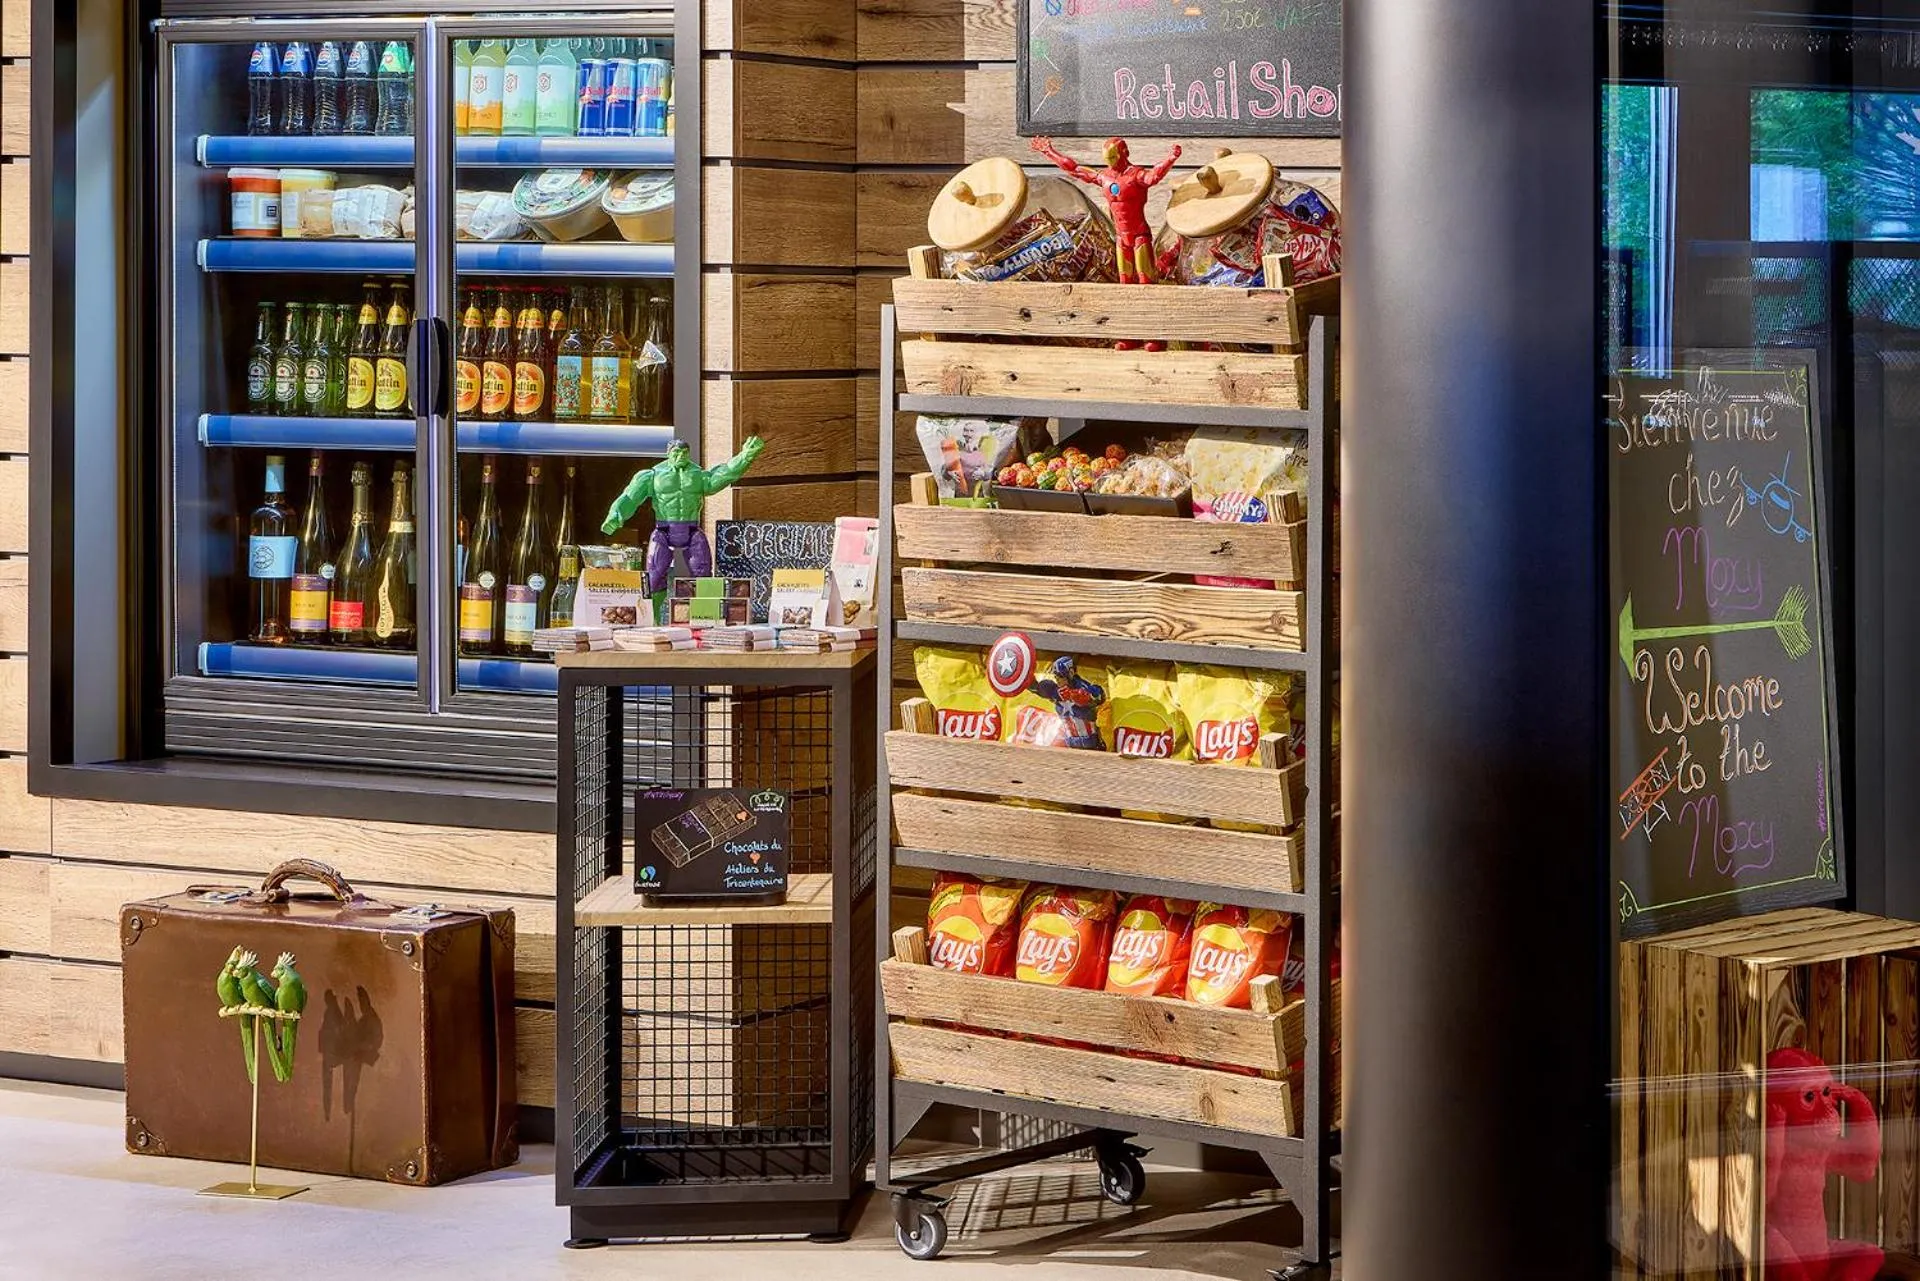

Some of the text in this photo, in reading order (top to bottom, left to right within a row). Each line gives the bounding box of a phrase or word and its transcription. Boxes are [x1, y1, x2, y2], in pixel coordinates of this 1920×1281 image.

[1114, 58, 1341, 121] Retail Sho
[1003, 236, 1062, 274] BOUNTY
[1668, 453, 1744, 528] chez
[1663, 527, 1763, 614] Moxy
[1634, 645, 1783, 734] Welcome
[1199, 718, 1256, 762] Lay's
[1677, 723, 1772, 793] to the
[1678, 794, 1775, 878] Moxy
[930, 932, 981, 971] Lay's
[1017, 930, 1077, 974] Lay's
[1110, 927, 1160, 967] Lay's
[1190, 939, 1248, 989] Lay's
